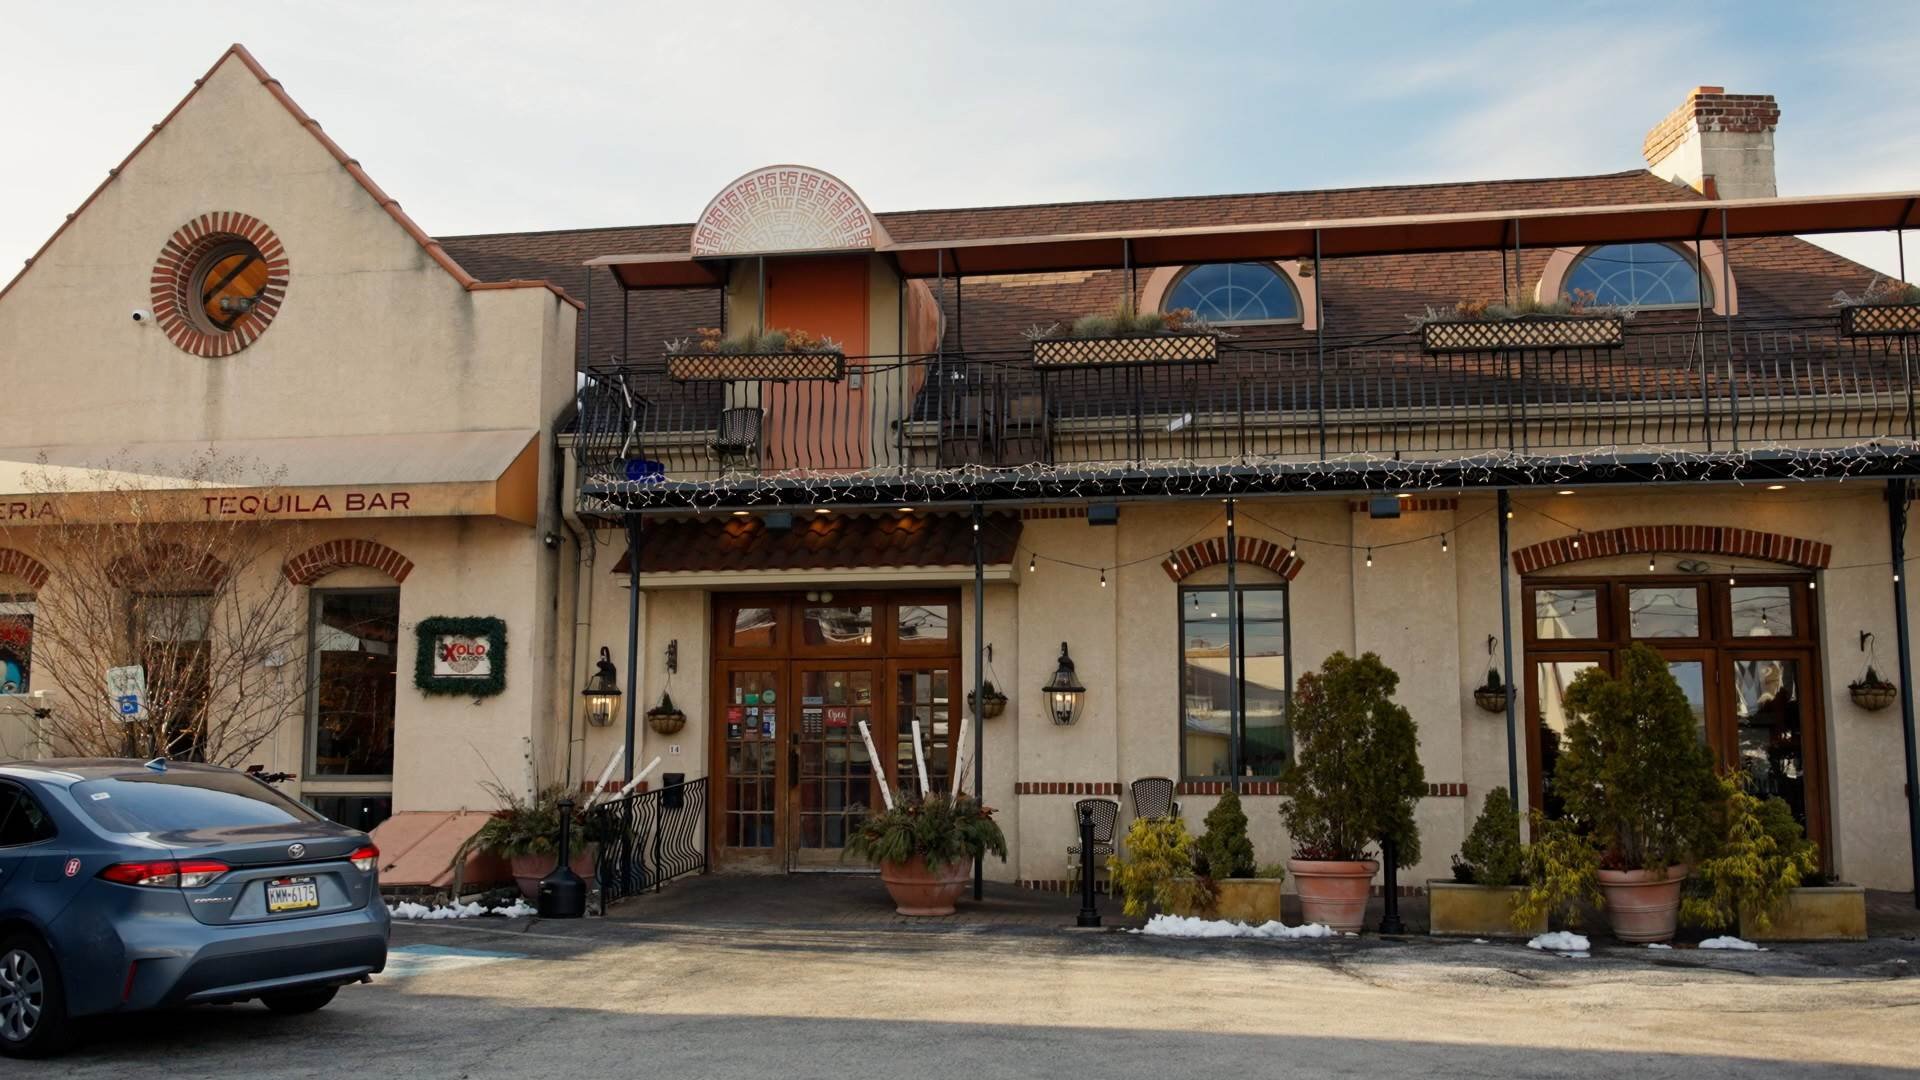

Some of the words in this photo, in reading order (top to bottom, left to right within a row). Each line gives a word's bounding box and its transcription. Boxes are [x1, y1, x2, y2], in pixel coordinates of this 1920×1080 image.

[202, 494, 332, 515] TEQUILA
[345, 492, 411, 511] BAR
[441, 643, 485, 662] XOLO
[827, 709, 847, 722] Open
